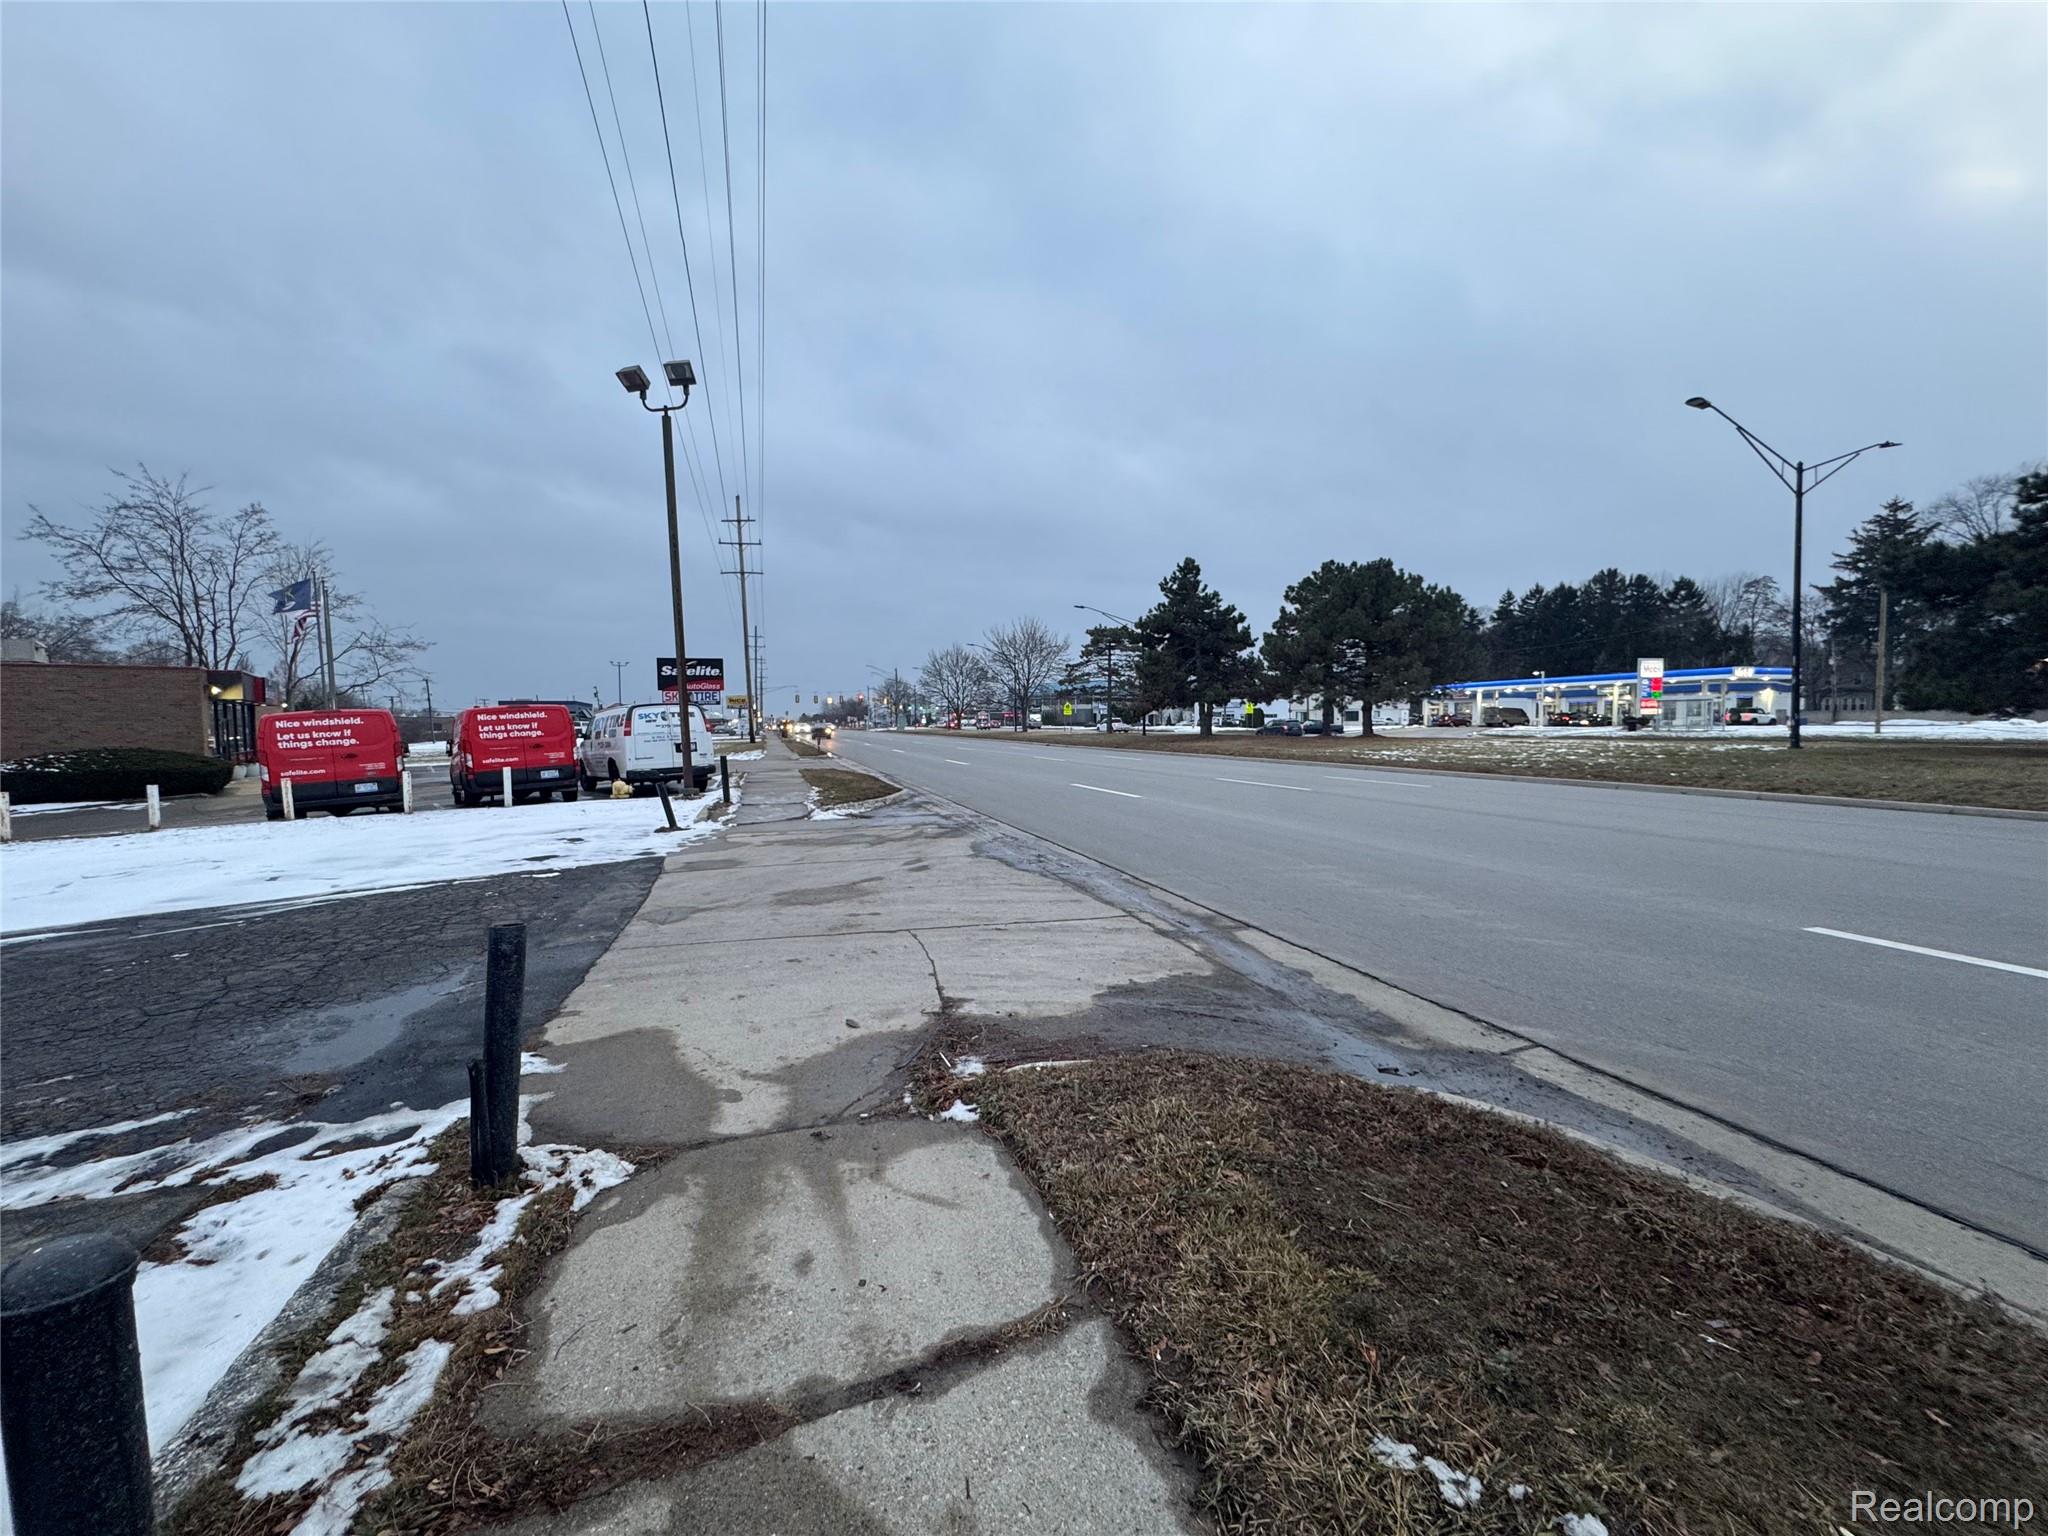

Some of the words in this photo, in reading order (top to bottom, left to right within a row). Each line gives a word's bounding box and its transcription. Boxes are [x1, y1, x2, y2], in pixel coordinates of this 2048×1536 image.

[694, 692, 718, 701] TIRE
[477, 713, 497, 721] Nice
[499, 711, 548, 720] windshield.
[275, 720, 300, 729] Nice
[303, 717, 365, 727] windshield.
[478, 724, 493, 732] Let
[276, 732, 295, 741] Let
[312, 730, 342, 738] know
[343, 729, 352, 737] if
[479, 731, 508, 740] things
[509, 729, 545, 738] change.
[277, 739, 313, 749] things
[315, 738, 360, 747] change.
[482, 756, 519, 764] safelite.com
[280, 768, 326, 777] safelite.com
